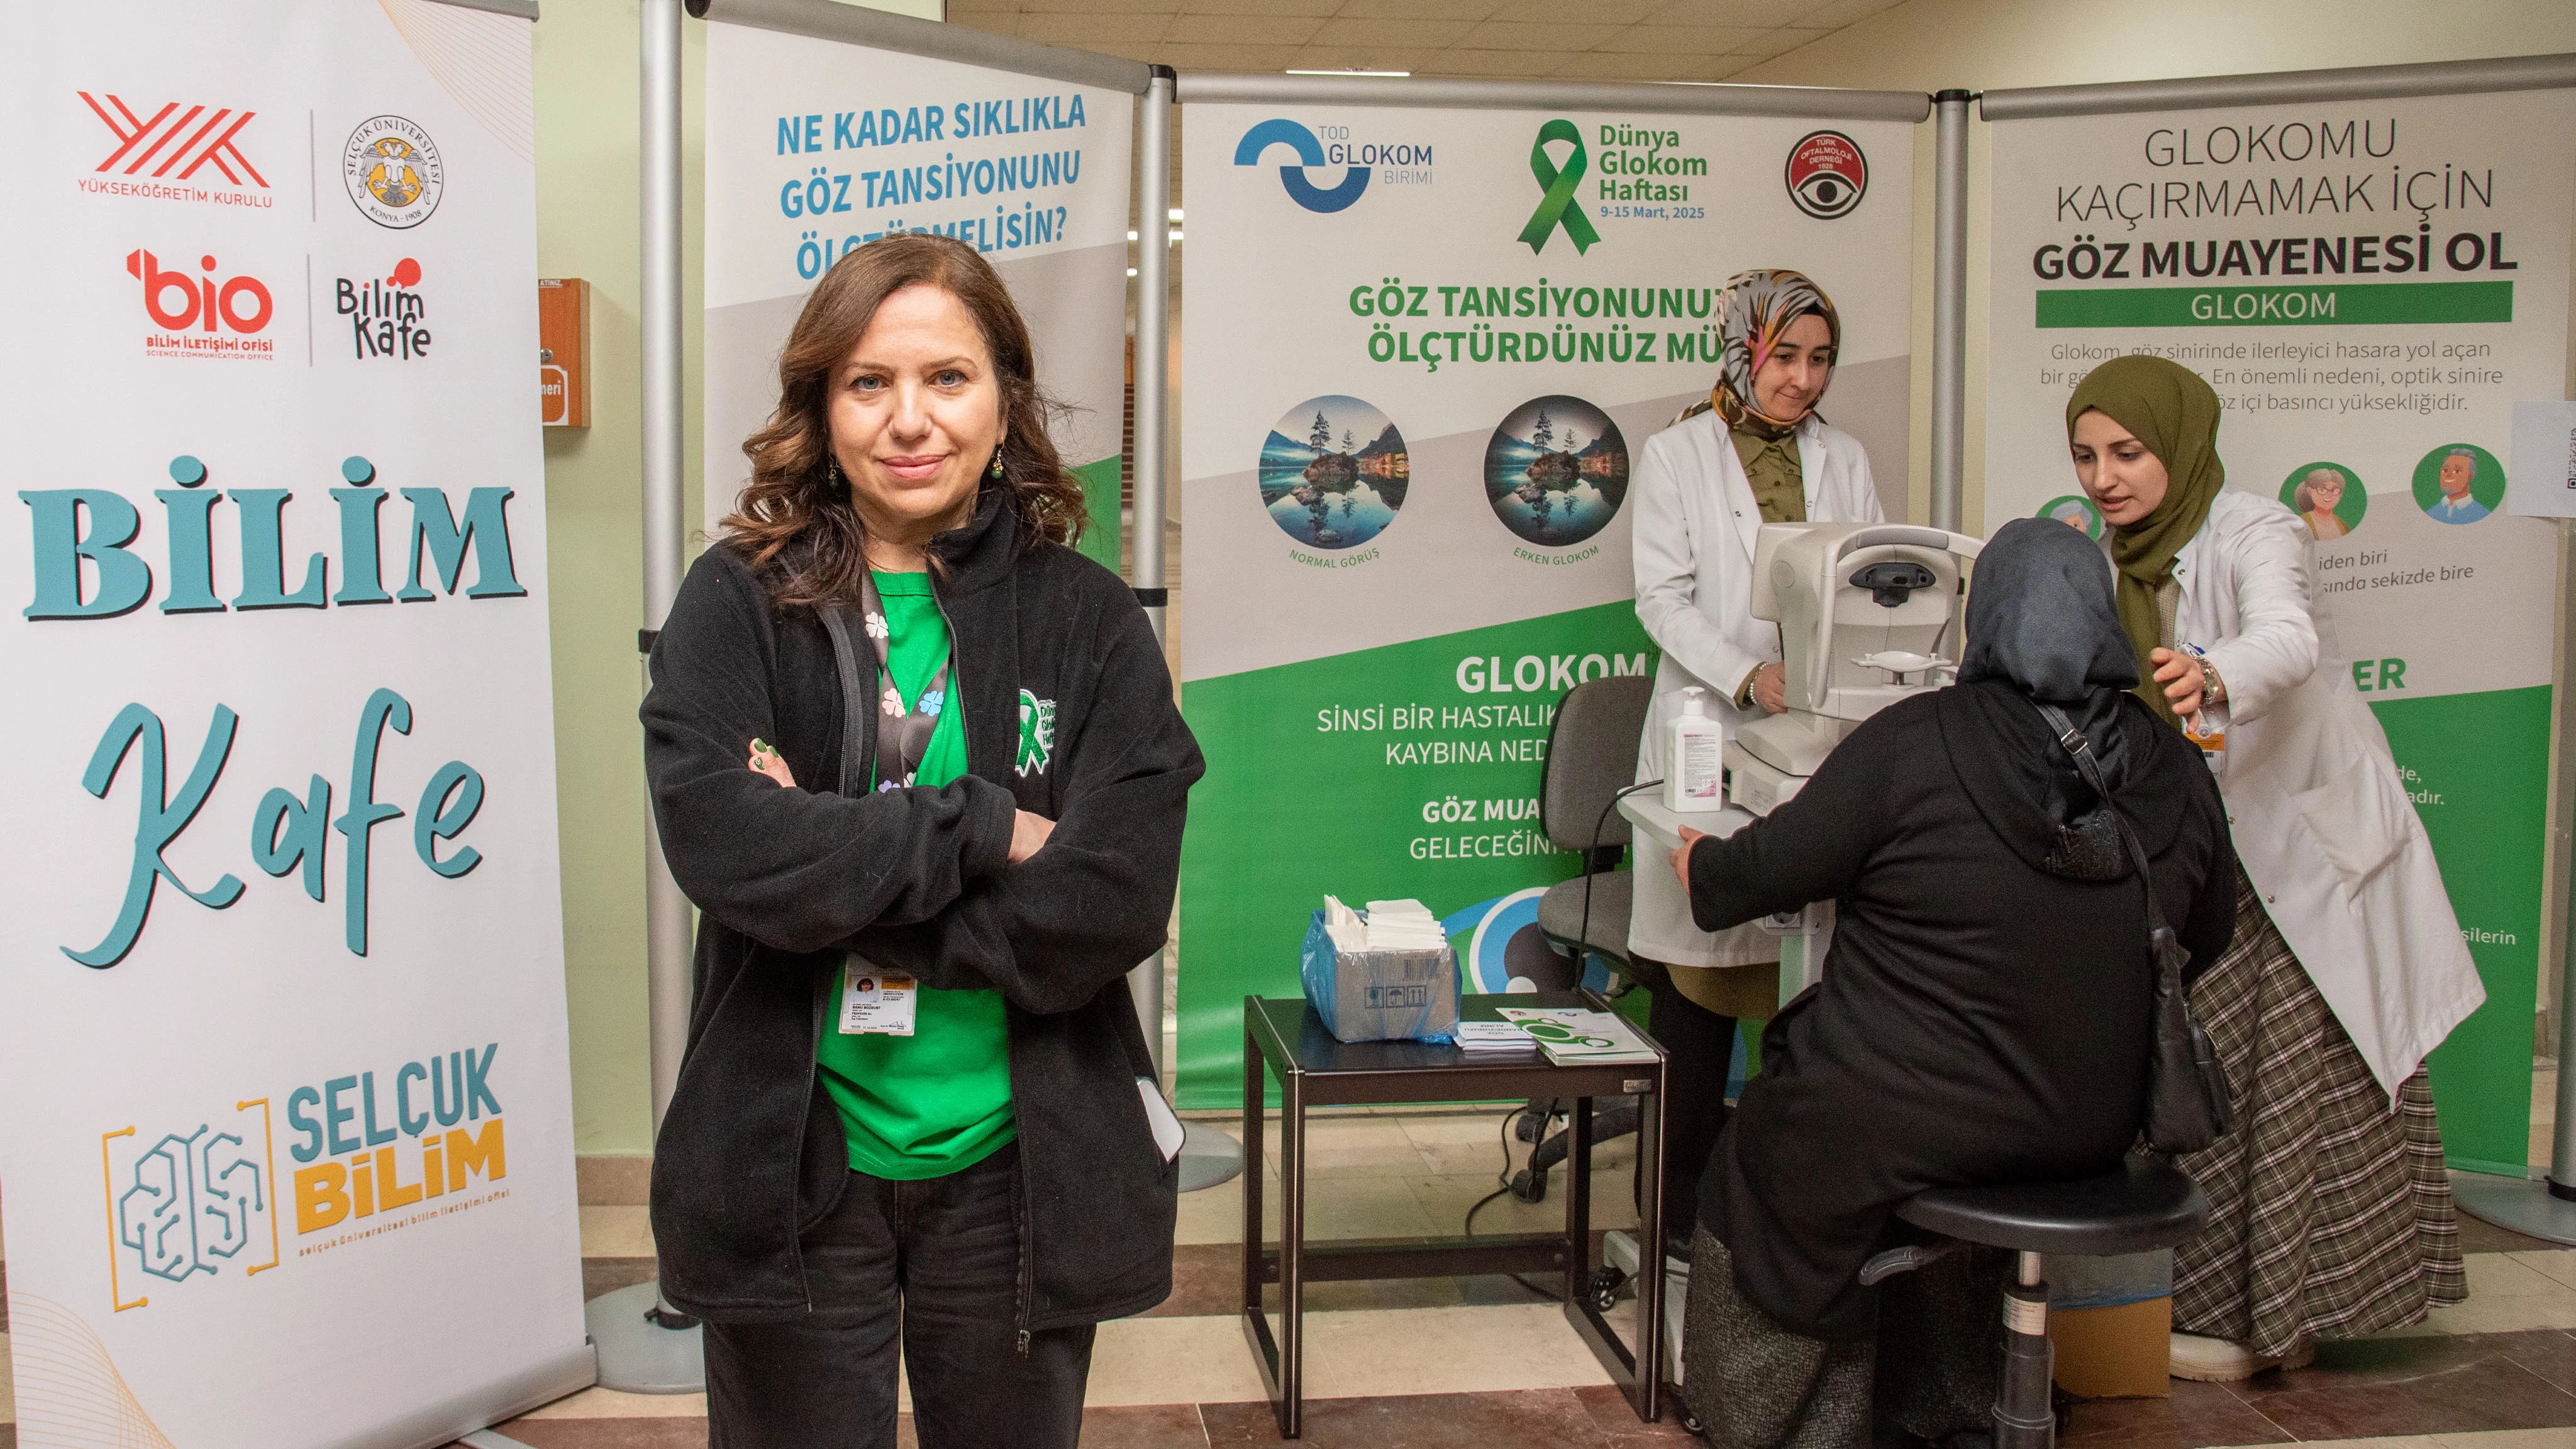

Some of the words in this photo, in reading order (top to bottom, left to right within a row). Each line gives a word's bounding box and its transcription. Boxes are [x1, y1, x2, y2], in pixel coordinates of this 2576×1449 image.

[777, 114, 823, 155] NE
[834, 104, 945, 150] KADAR
[954, 94, 1086, 139] SIKLIKLA
[1319, 126, 1350, 140] TOD
[1599, 125, 1679, 151] Dünya
[347, 126, 373, 176] SELÇUK
[1329, 144, 1433, 165] GLOKOM
[1816, 138, 1836, 146] TÜRK
[2145, 118, 2397, 169] GLOKOMU
[1384, 168, 1433, 185] BİRİMİ
[1599, 150, 1707, 176] Glokom
[78, 177, 208, 203] YÜKSEKÖĞRETİM
[214, 192, 272, 208] KURULU
[780, 166, 852, 219] GÖZ
[862, 150, 1080, 209] TANSİYONUNU
[1600, 179, 1689, 201] Haftası
[2057, 172, 2375, 231] KAÇIRMAMAK
[2392, 162, 2494, 222] İÇİN
[370, 205, 399, 222] KONYA
[404, 209, 422, 221] 1908
[1601, 206, 1630, 218] 9-15
[1633, 206, 1669, 220] Mart,
[1673, 207, 1705, 219] 2025
[2032, 236, 2130, 280] GÖZ
[2141, 223, 2430, 278] MUAYENESİ
[2445, 231, 2518, 273] OL
[127, 248, 273, 334] bio
[336, 277, 424, 321] Bilim
[1350, 277, 1428, 318] GÖZ
[1437, 277, 1722, 319] TANSİYONUNU
[2190, 291, 2337, 321] GLOKOM
[146, 334, 180, 348] BİLİM
[184, 335, 238, 352] İLETİŞİMİ
[242, 338, 273, 352] OFİSİ
[353, 312, 431, 360] Kafe
[1367, 322, 1657, 373] ÖLÇTÜRDÜNÜZ
[1667, 324, 1722, 364] MÜ
[181, 350, 245, 360] COMMUNICATION
[2167, 343, 2246, 360] sinirinde
[2252, 341, 2329, 364] ilerleyici
[2336, 341, 2401, 358] hasara
[2406, 340, 2436, 362] yol
[2442, 342, 2491, 362] açan
[2041, 369, 2063, 385] bir
[2213, 368, 2235, 385] En
[2241, 367, 2307, 386] önemli
[2312, 367, 2385, 387] nedeni,
[2390, 367, 2443, 389] optik
[2447, 367, 2503, 385] sinire
[2219, 394, 2235, 410] öz
[2241, 394, 2262, 414] içi
[2267, 393, 2334, 410] basıncı
[2339, 392, 2468, 415] yüksekliğidir.
[18, 455, 527, 621] BİLİM
[1289, 548, 1338, 568] NORMAL
[1340, 547, 1380, 568] GÖRÜŞ
[1513, 546, 1550, 565] ERKEN
[1552, 544, 1599, 565] GLOKOM
[2360, 549, 2388, 566] biri
[2371, 568, 2435, 589] sekizde
[2440, 565, 2473, 581] bire
[1455, 652, 1647, 694] GLOKOM
[2352, 657, 2407, 692] ER
[1317, 702, 1384, 732] SİNSİ
[1392, 702, 1434, 730] BİR
[1385, 741, 1494, 765] KAYBINA
[1422, 796, 1477, 823] GÖZ
[60, 687, 484, 969] Kafe
[1410, 830, 1557, 860] GELECEĞİN
[287, 1043, 502, 1162] SELÇUK
[293, 1118, 506, 1235] BİLİM
[299, 1238, 337, 1257] selçuk
[411, 1209, 439, 1226] bilim
